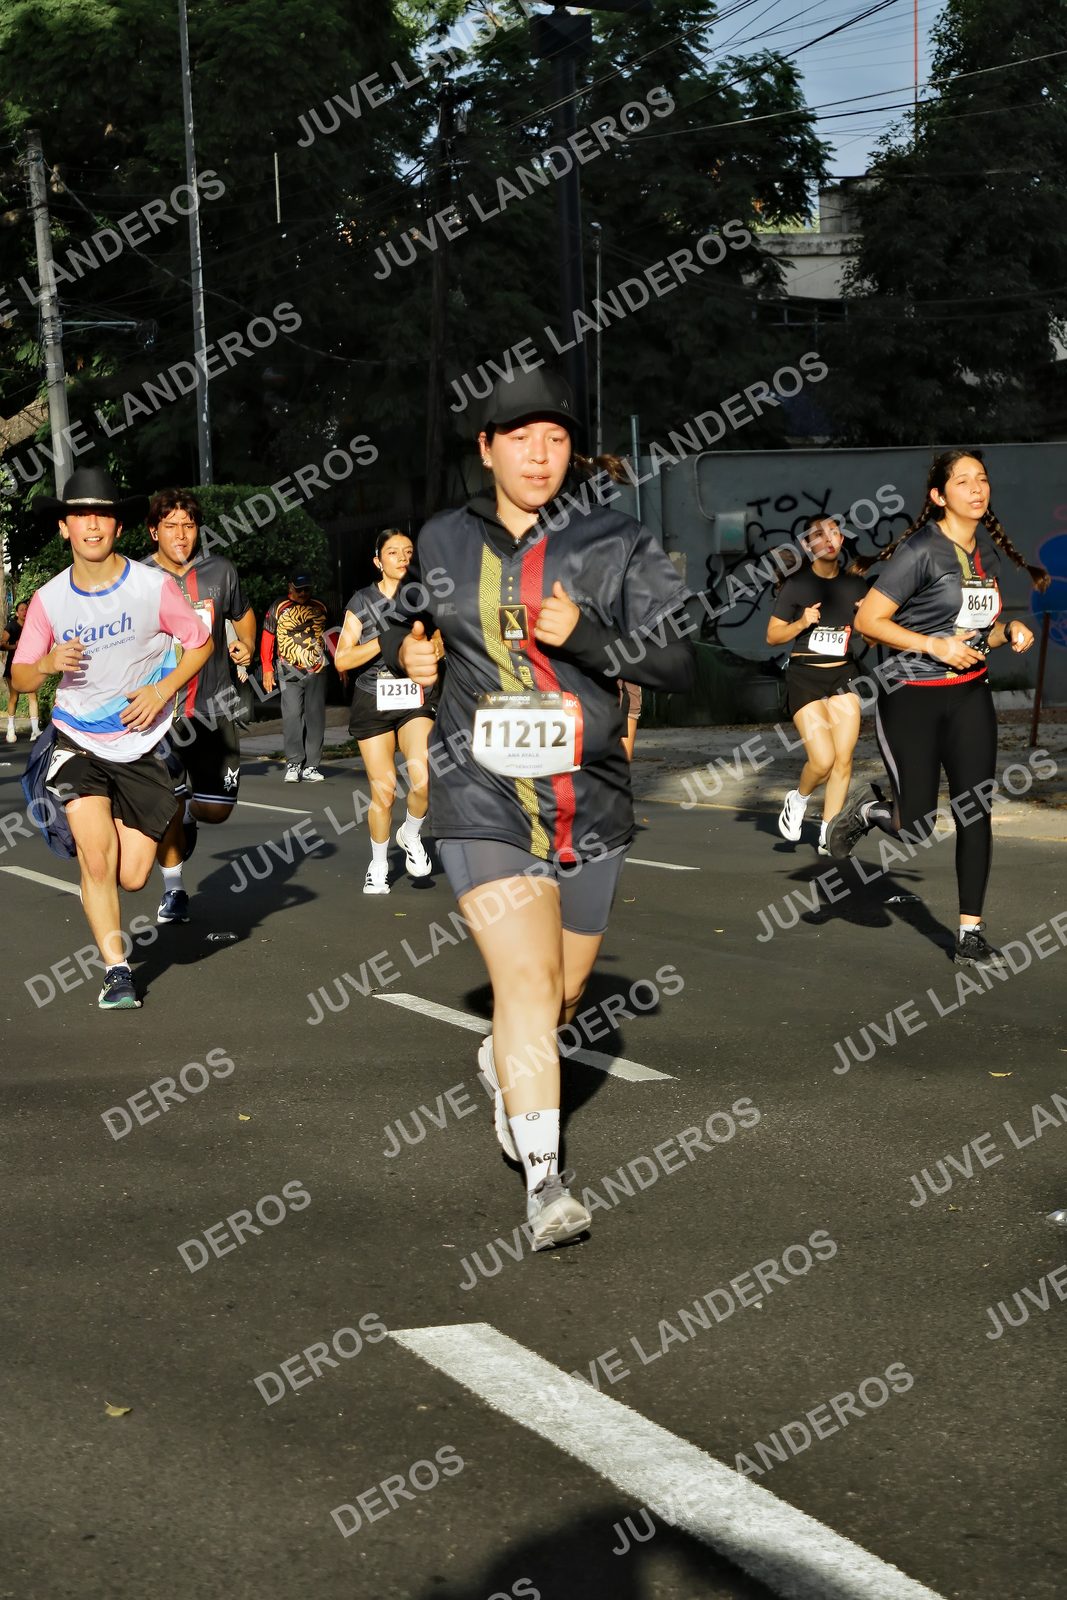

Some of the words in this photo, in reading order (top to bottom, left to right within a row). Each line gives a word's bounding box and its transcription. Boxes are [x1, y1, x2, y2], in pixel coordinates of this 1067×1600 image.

[746, 488, 832, 517] TOY
[968, 595, 993, 611] 8641
[813, 632, 844, 644] 13196
[379, 683, 418, 697] 12318
[481, 720, 567, 747] 11212
